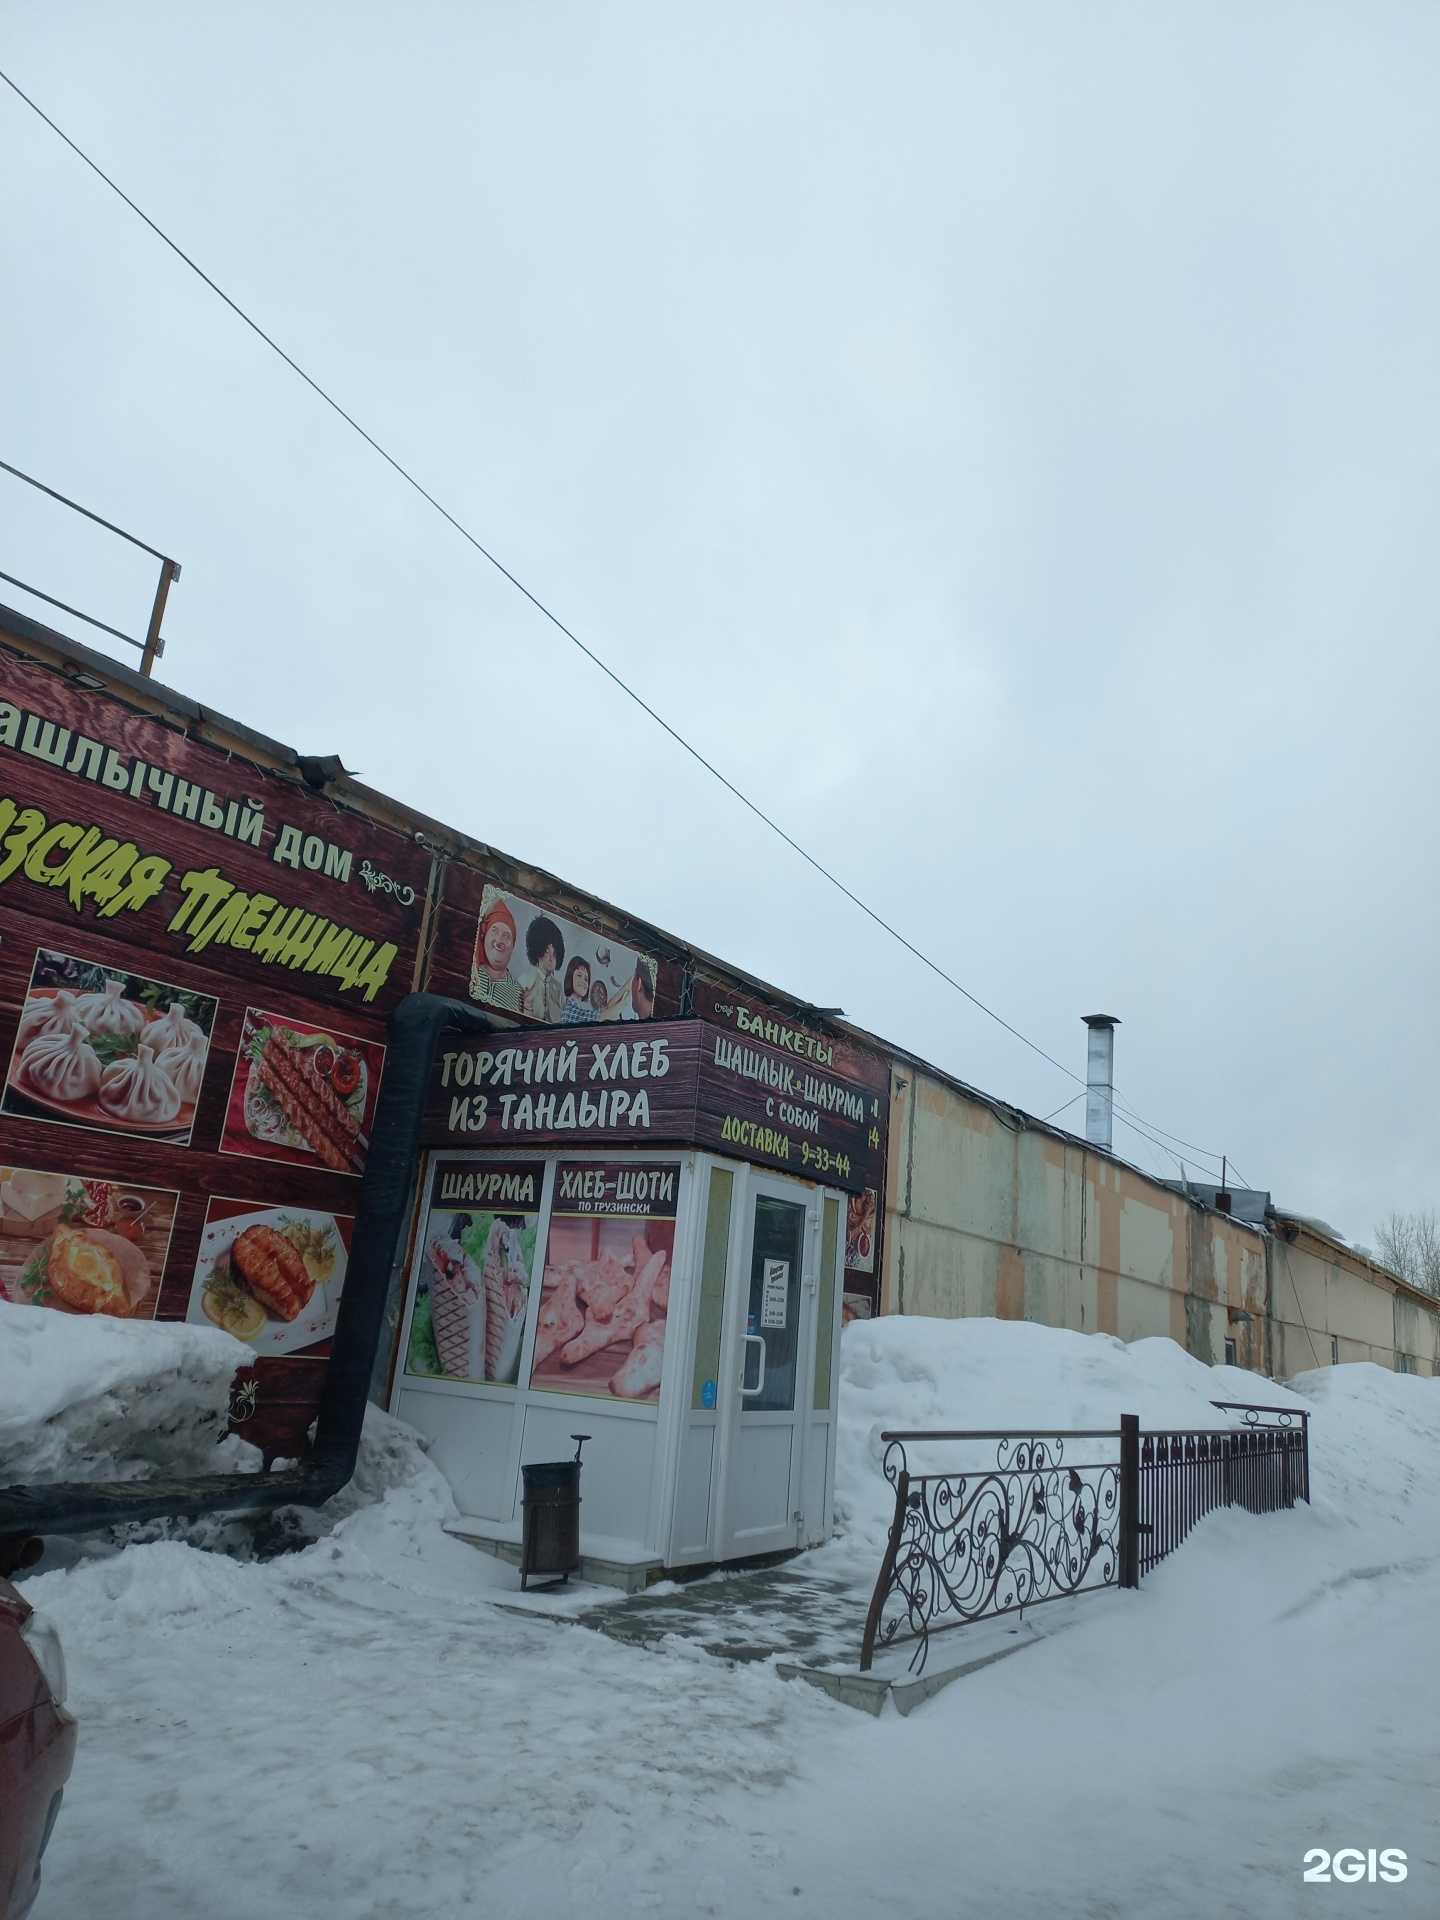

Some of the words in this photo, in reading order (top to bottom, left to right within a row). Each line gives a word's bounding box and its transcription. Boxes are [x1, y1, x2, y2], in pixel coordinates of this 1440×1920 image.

[274, 824, 353, 882] дом
[736, 1006, 832, 1066] БАНКЕТЫ
[441, 1040, 578, 1087] ГОРЯЧИЙ
[589, 1039, 669, 1081] ХЛЕБ
[448, 1095, 488, 1132] ИЗ
[499, 1089, 650, 1130] ТАНДЫРА
[766, 1097, 774, 1117] С
[779, 1102, 819, 1134] СОБОЙ
[721, 1115, 789, 1160] ДОСТАВКА
[801, 1141, 850, 1178] 9-33-44
[441, 1172, 534, 1202] ШАУРМА
[560, 1169, 674, 1202] ХЛЕБ-ШОТИ
[578, 1201, 592, 1212] ПО
[595, 1202, 650, 1214] ГРУЗИНСКИ
